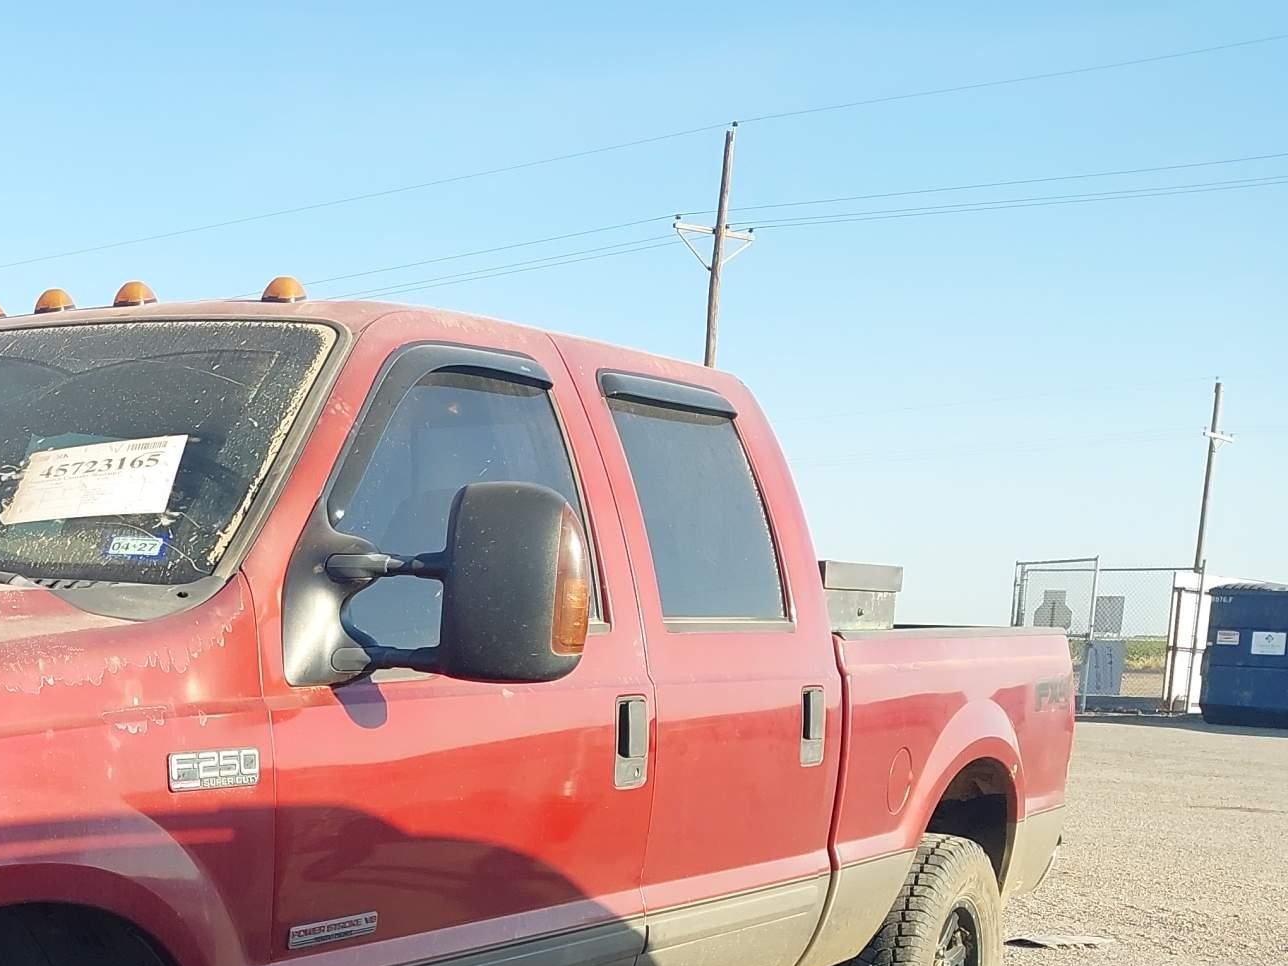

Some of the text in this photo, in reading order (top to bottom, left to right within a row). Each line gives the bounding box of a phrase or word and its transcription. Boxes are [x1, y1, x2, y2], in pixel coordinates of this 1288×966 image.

[39, 453, 163, 479] 45723165
[202, 775, 257, 788] SUPER DUTY
[291, 925, 325, 938] POWER
[326, 918, 363, 933] STROKE
